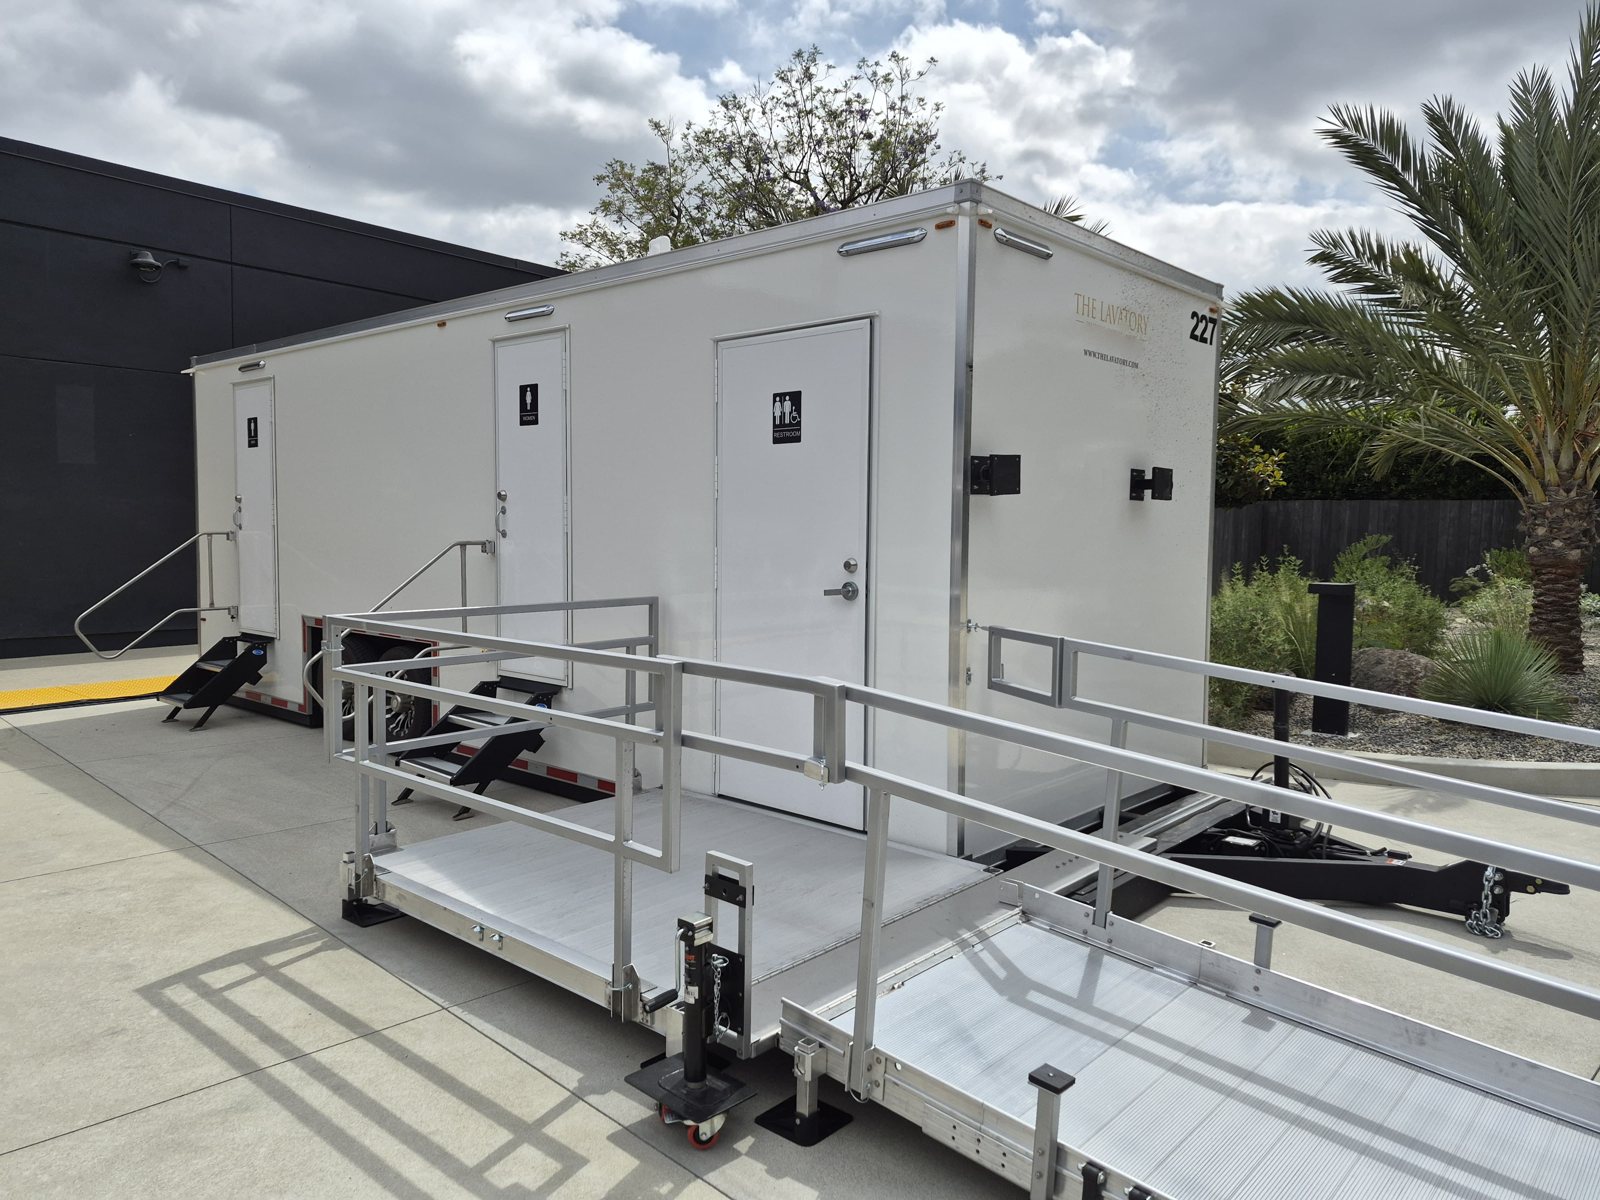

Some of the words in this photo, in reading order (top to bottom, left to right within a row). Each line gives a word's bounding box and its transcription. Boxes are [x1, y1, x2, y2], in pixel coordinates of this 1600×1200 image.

[1074, 292, 1097, 319] THE
[1100, 300, 1150, 335] LAVATORY
[1190, 311, 1217, 345] 227
[1083, 348, 1139, 369] WWW.THELAVATORY.COM
[773, 430, 801, 438] RESTROOM
